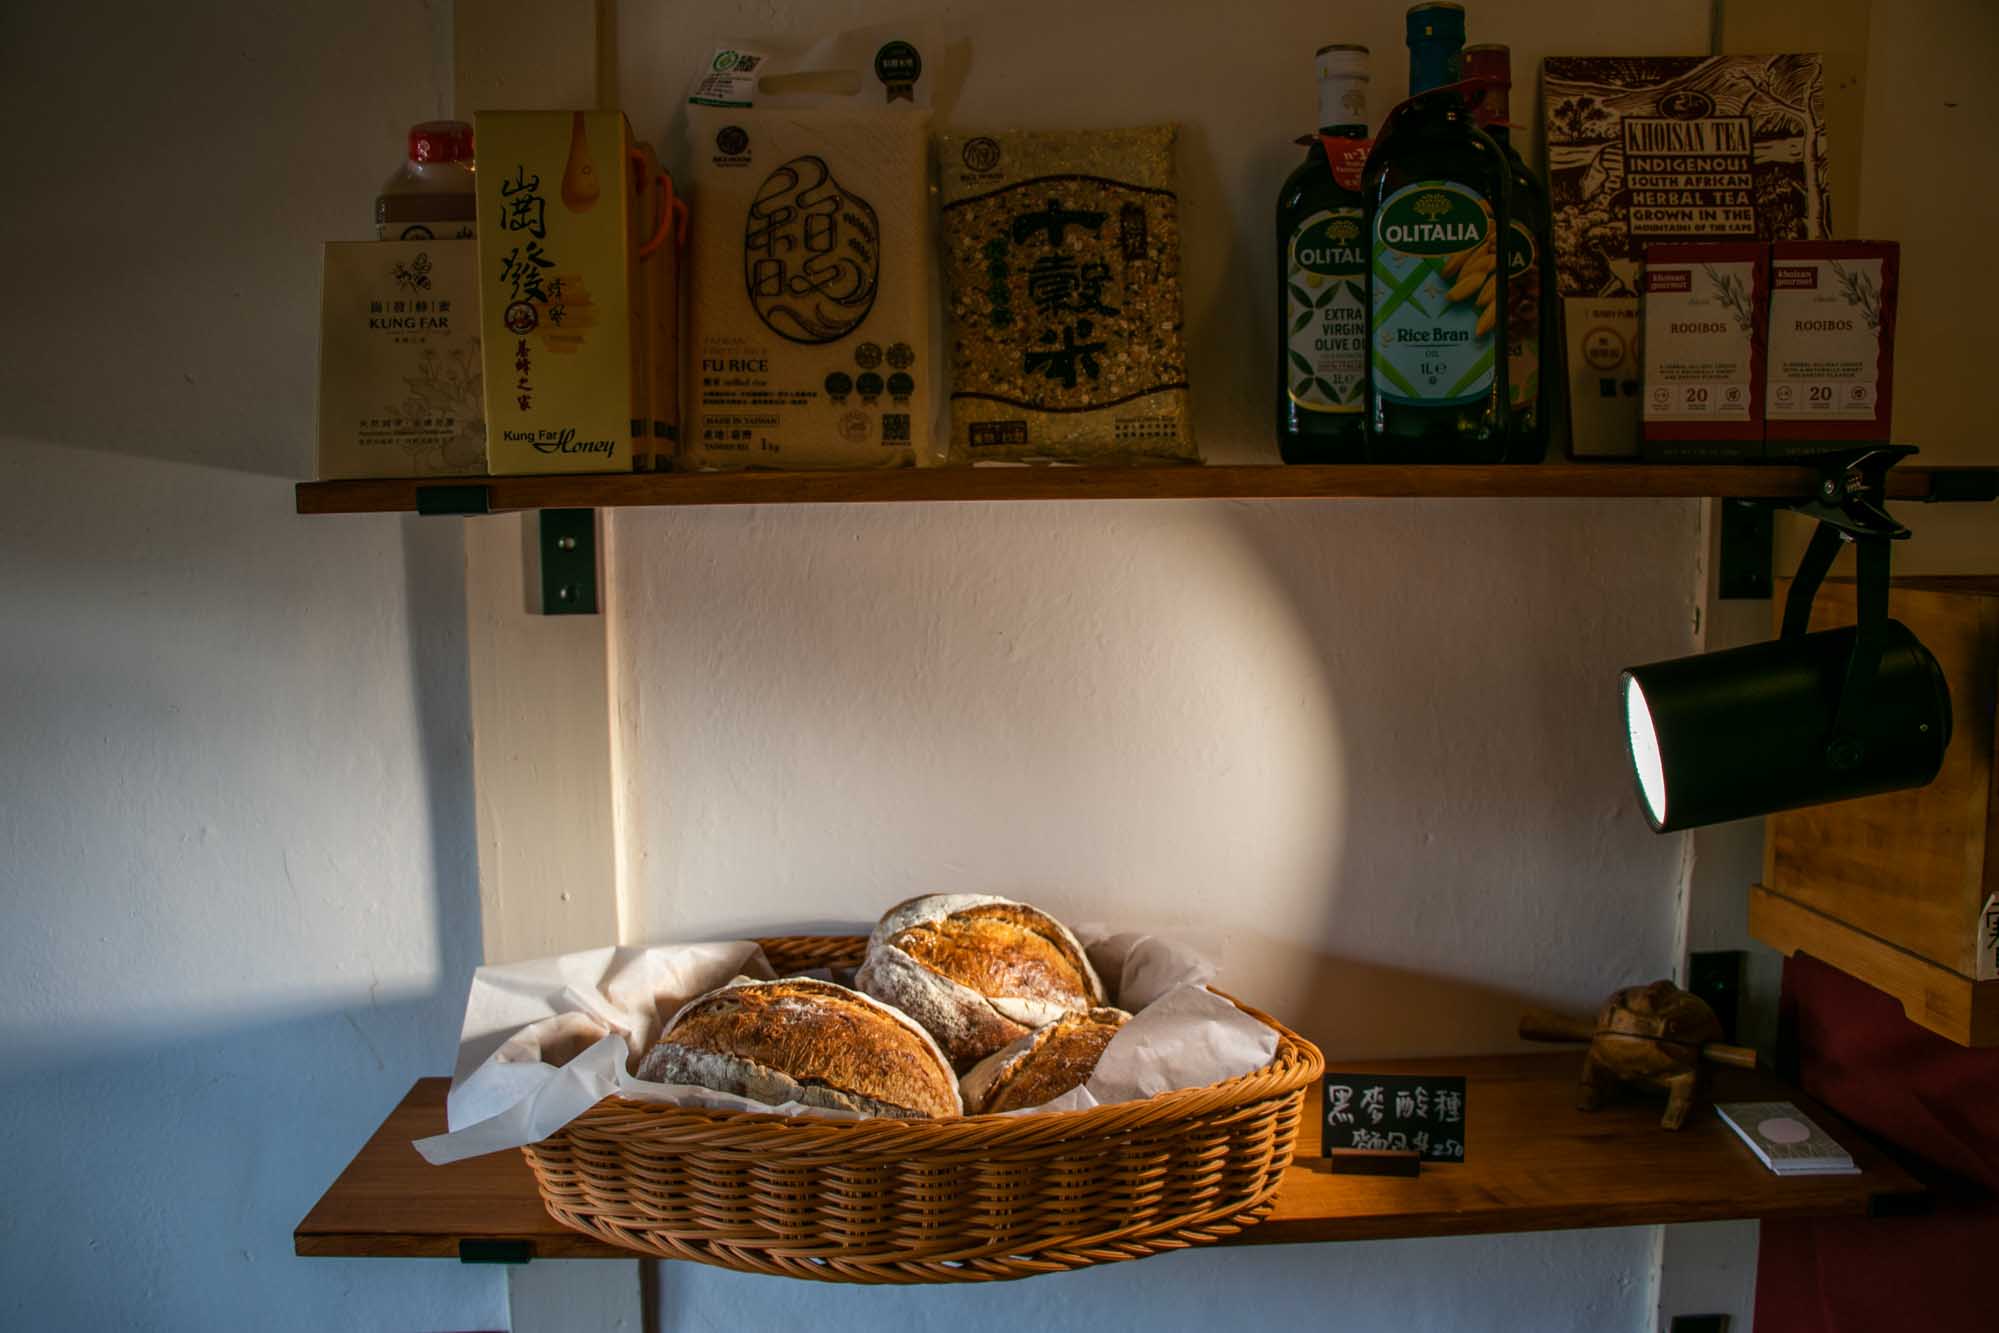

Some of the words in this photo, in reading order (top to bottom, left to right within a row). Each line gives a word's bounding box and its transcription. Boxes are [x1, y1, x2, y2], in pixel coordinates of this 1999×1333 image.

[1628, 122, 1704, 152] KHOISAN
[1711, 122, 1747, 152] TEA
[1629, 158, 1748, 172] INDIGENOUS
[1632, 176, 1679, 187] SOUTH
[1684, 175, 1749, 187] AFRICAN
[1632, 191, 1704, 205] HERBAL
[1713, 191, 1750, 205] TEA
[1633, 210, 1693, 221] GROWN
[1700, 210, 1717, 220] IN
[1723, 209, 1752, 220] THE
[1385, 223, 1480, 243] OLITALIA
[1694, 224, 1706, 232] OF
[1710, 224, 1725, 232] THE
[1325, 308, 1362, 320] EXTRA
[370, 317, 415, 329] KUNG
[420, 317, 449, 329] FAR
[1322, 323, 1364, 336] VIRGIN
[1671, 323, 1727, 333] ROOIBOS
[1795, 320, 1853, 330] ROOIBOS
[1397, 328, 1429, 342] Rice
[1433, 328, 1469, 342] Bran
[1315, 338, 1351, 351] OLIVE
[703, 359, 724, 371] FU
[729, 359, 768, 371] RICE
[1687, 388, 1708, 401] 20
[1810, 387, 1832, 401] 20
[503, 430, 535, 443] Kung
[538, 430, 557, 441] Far
[534, 428, 615, 458] Honey
[1327, 1084, 1463, 1126] 黑麥酸種
